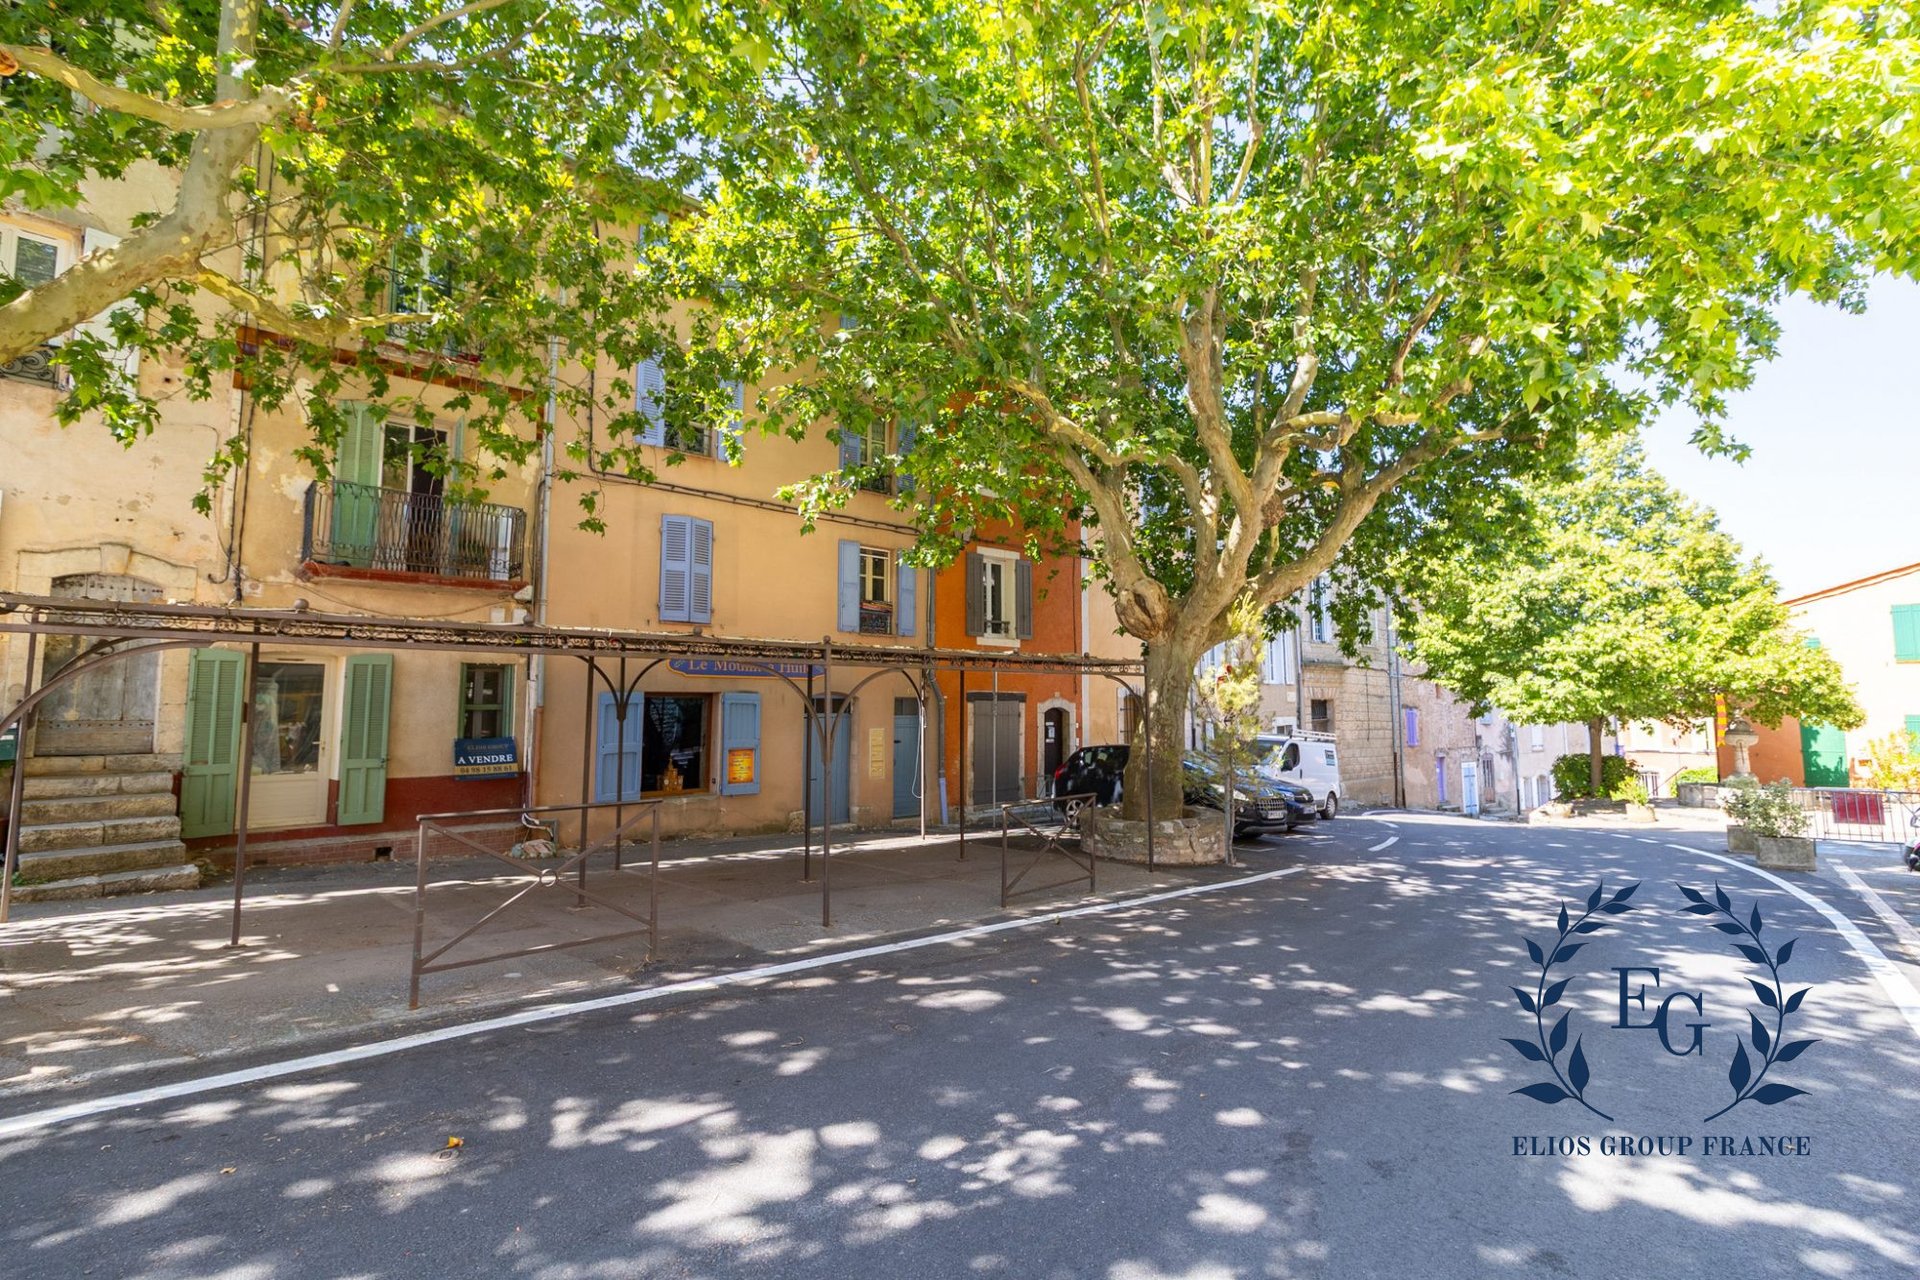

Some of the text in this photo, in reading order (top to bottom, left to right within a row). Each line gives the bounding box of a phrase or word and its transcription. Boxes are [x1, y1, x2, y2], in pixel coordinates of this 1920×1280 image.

[689, 659, 708, 670] Le
[780, 663, 812, 673] Huil
[457, 754, 514, 765] A VENDRE
